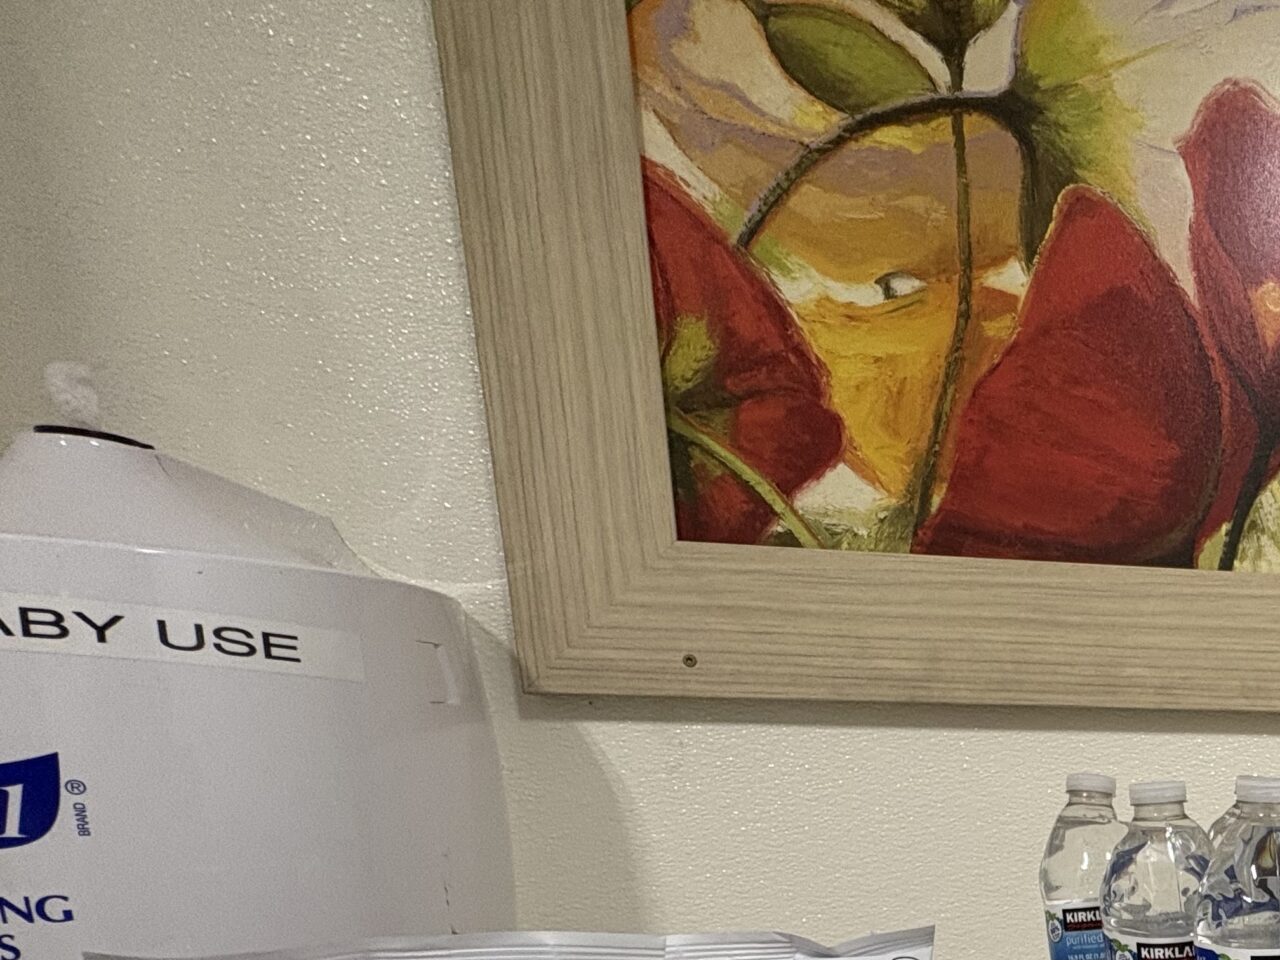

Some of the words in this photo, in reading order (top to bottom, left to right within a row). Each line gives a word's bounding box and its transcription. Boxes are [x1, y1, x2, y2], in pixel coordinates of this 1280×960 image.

[156, 619, 302, 663] USE
[73, 802, 91, 837] BRAND
[1065, 933, 1104, 946] purified
